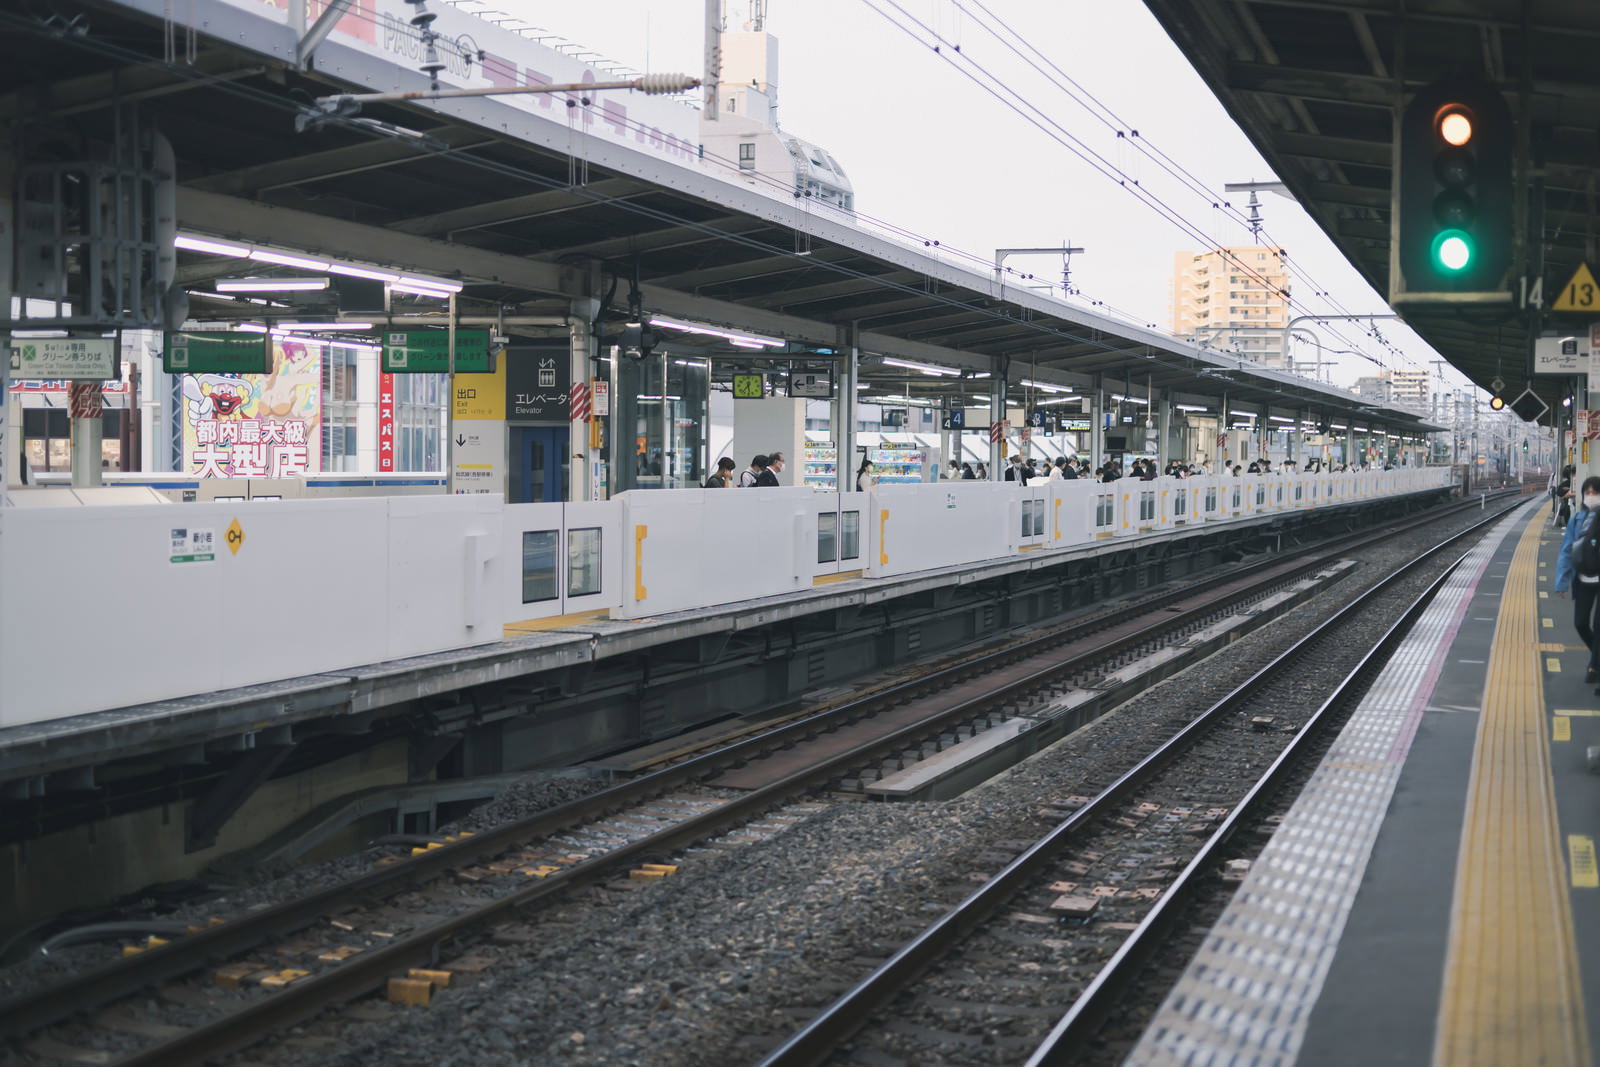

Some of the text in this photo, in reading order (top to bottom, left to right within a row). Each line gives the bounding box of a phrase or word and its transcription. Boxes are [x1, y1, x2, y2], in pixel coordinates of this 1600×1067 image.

[383, 11, 472, 80] PACNKO
[1520, 276, 1544, 310] 14
[1570, 283, 1594, 306] 13
[456, 389, 477, 399] 出口
[515, 393, 570, 405] エレベータ
[944, 420, 950, 429] 4
[953, 413, 961, 423] 4
[197, 420, 304, 444] 都内最大級
[193, 442, 307, 479] 大型店
